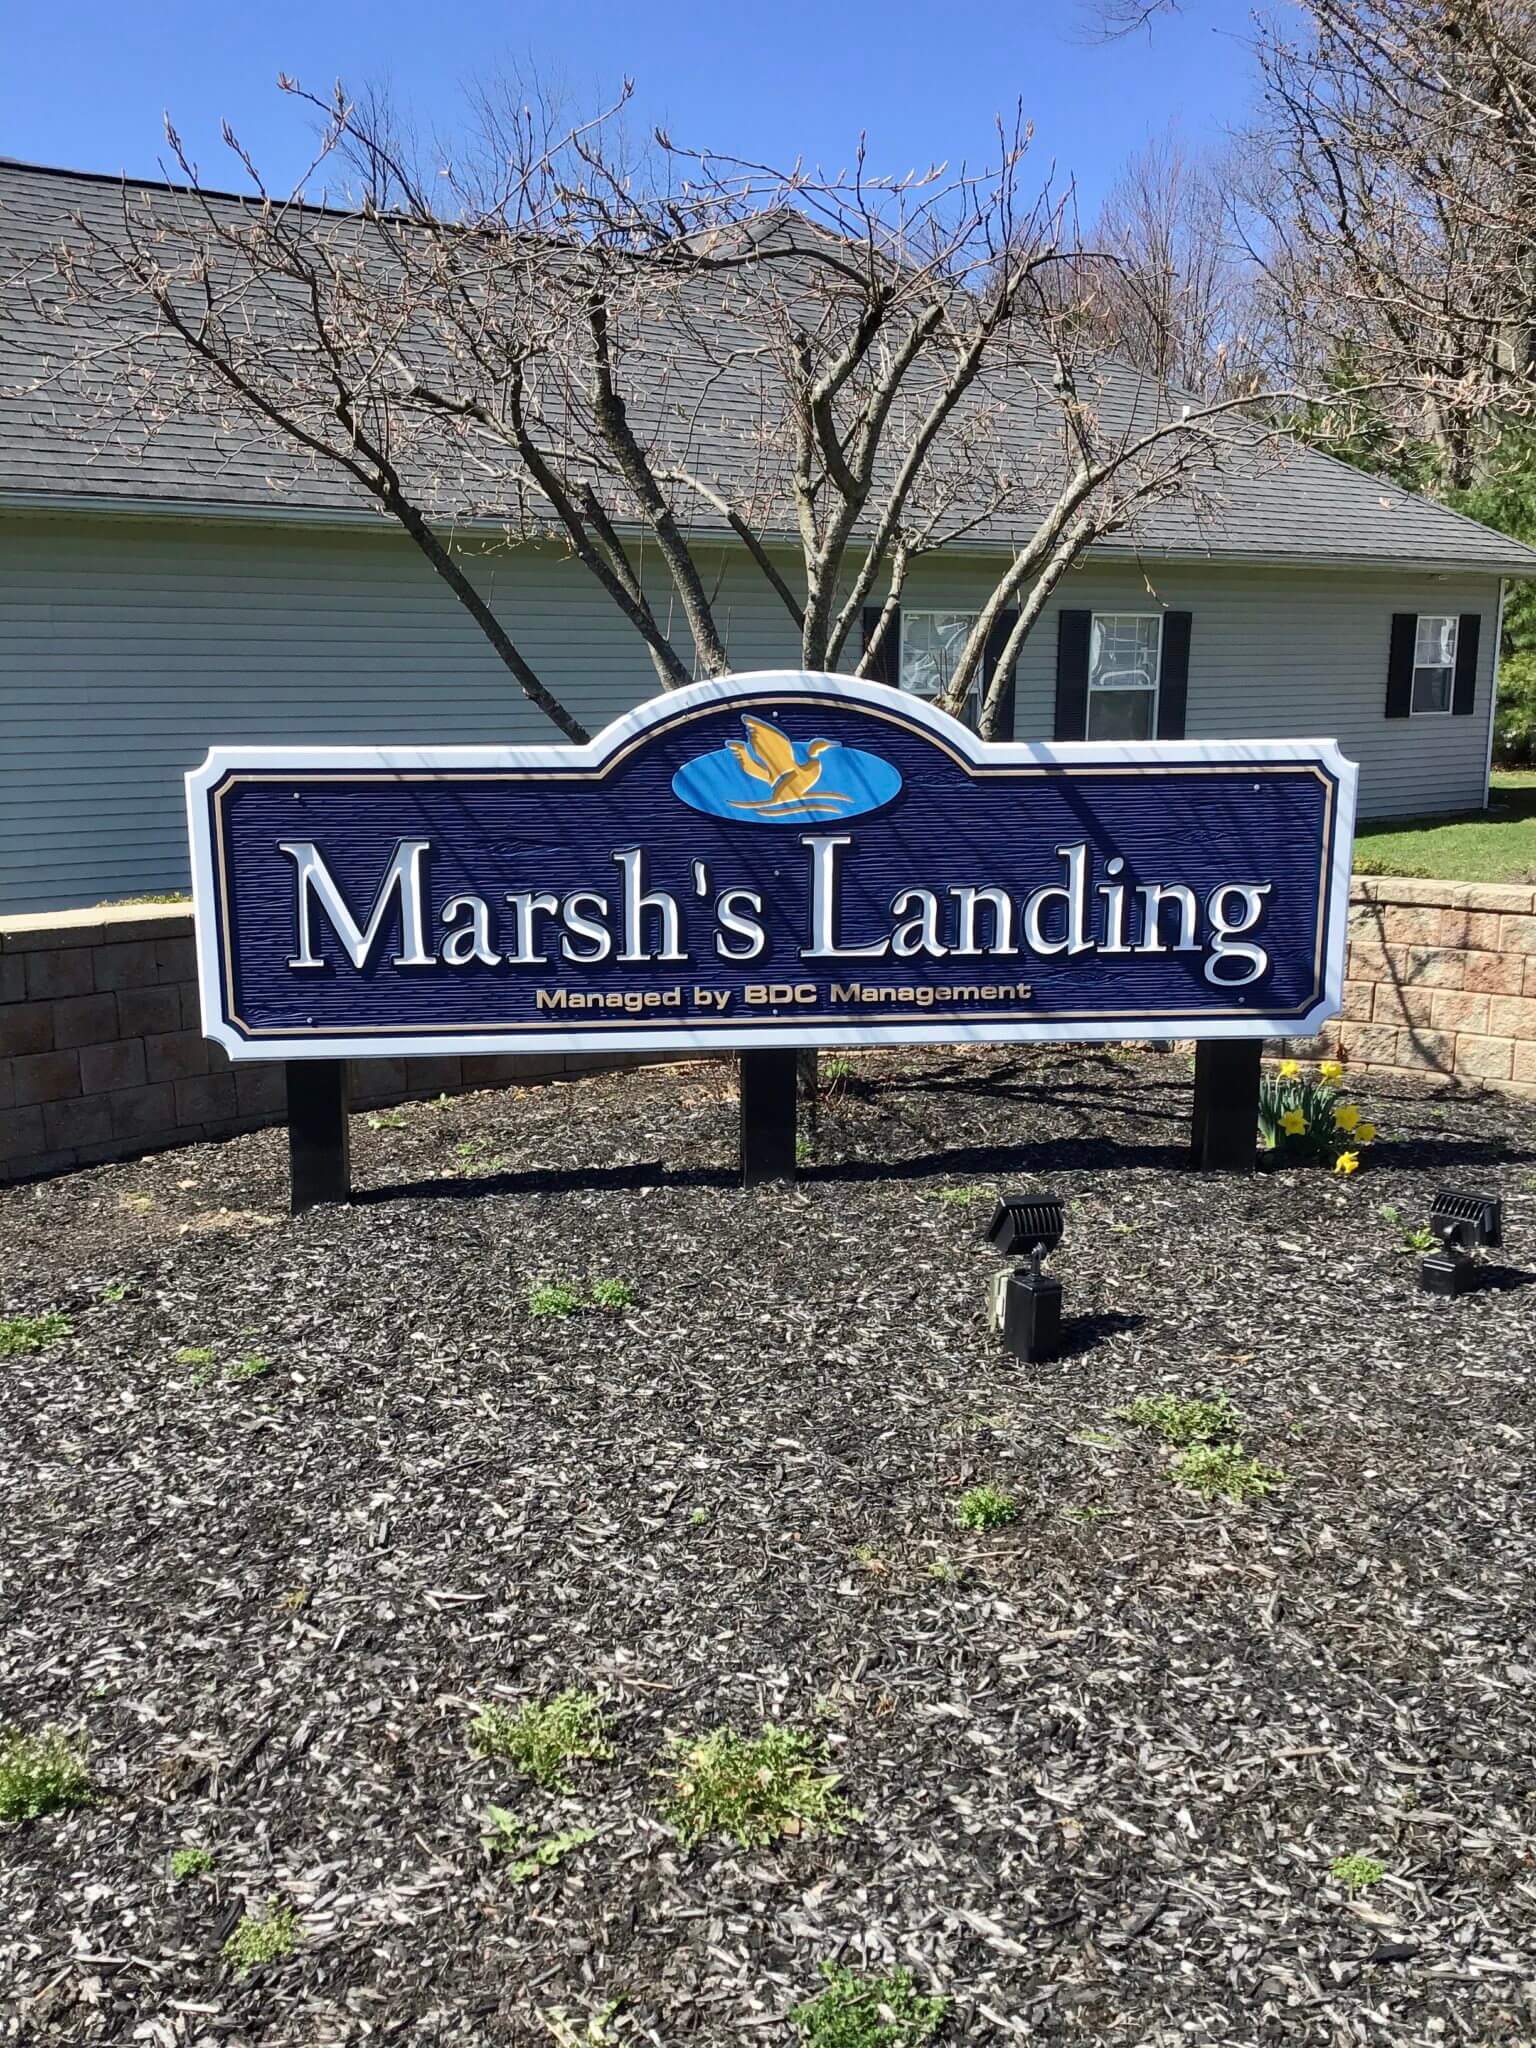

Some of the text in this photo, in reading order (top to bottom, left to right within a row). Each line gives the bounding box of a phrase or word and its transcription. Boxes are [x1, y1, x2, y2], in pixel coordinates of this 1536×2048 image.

[278, 835, 1273, 987] Marsh's Landing
[535, 982, 1032, 1012] Managed by BDC Management
